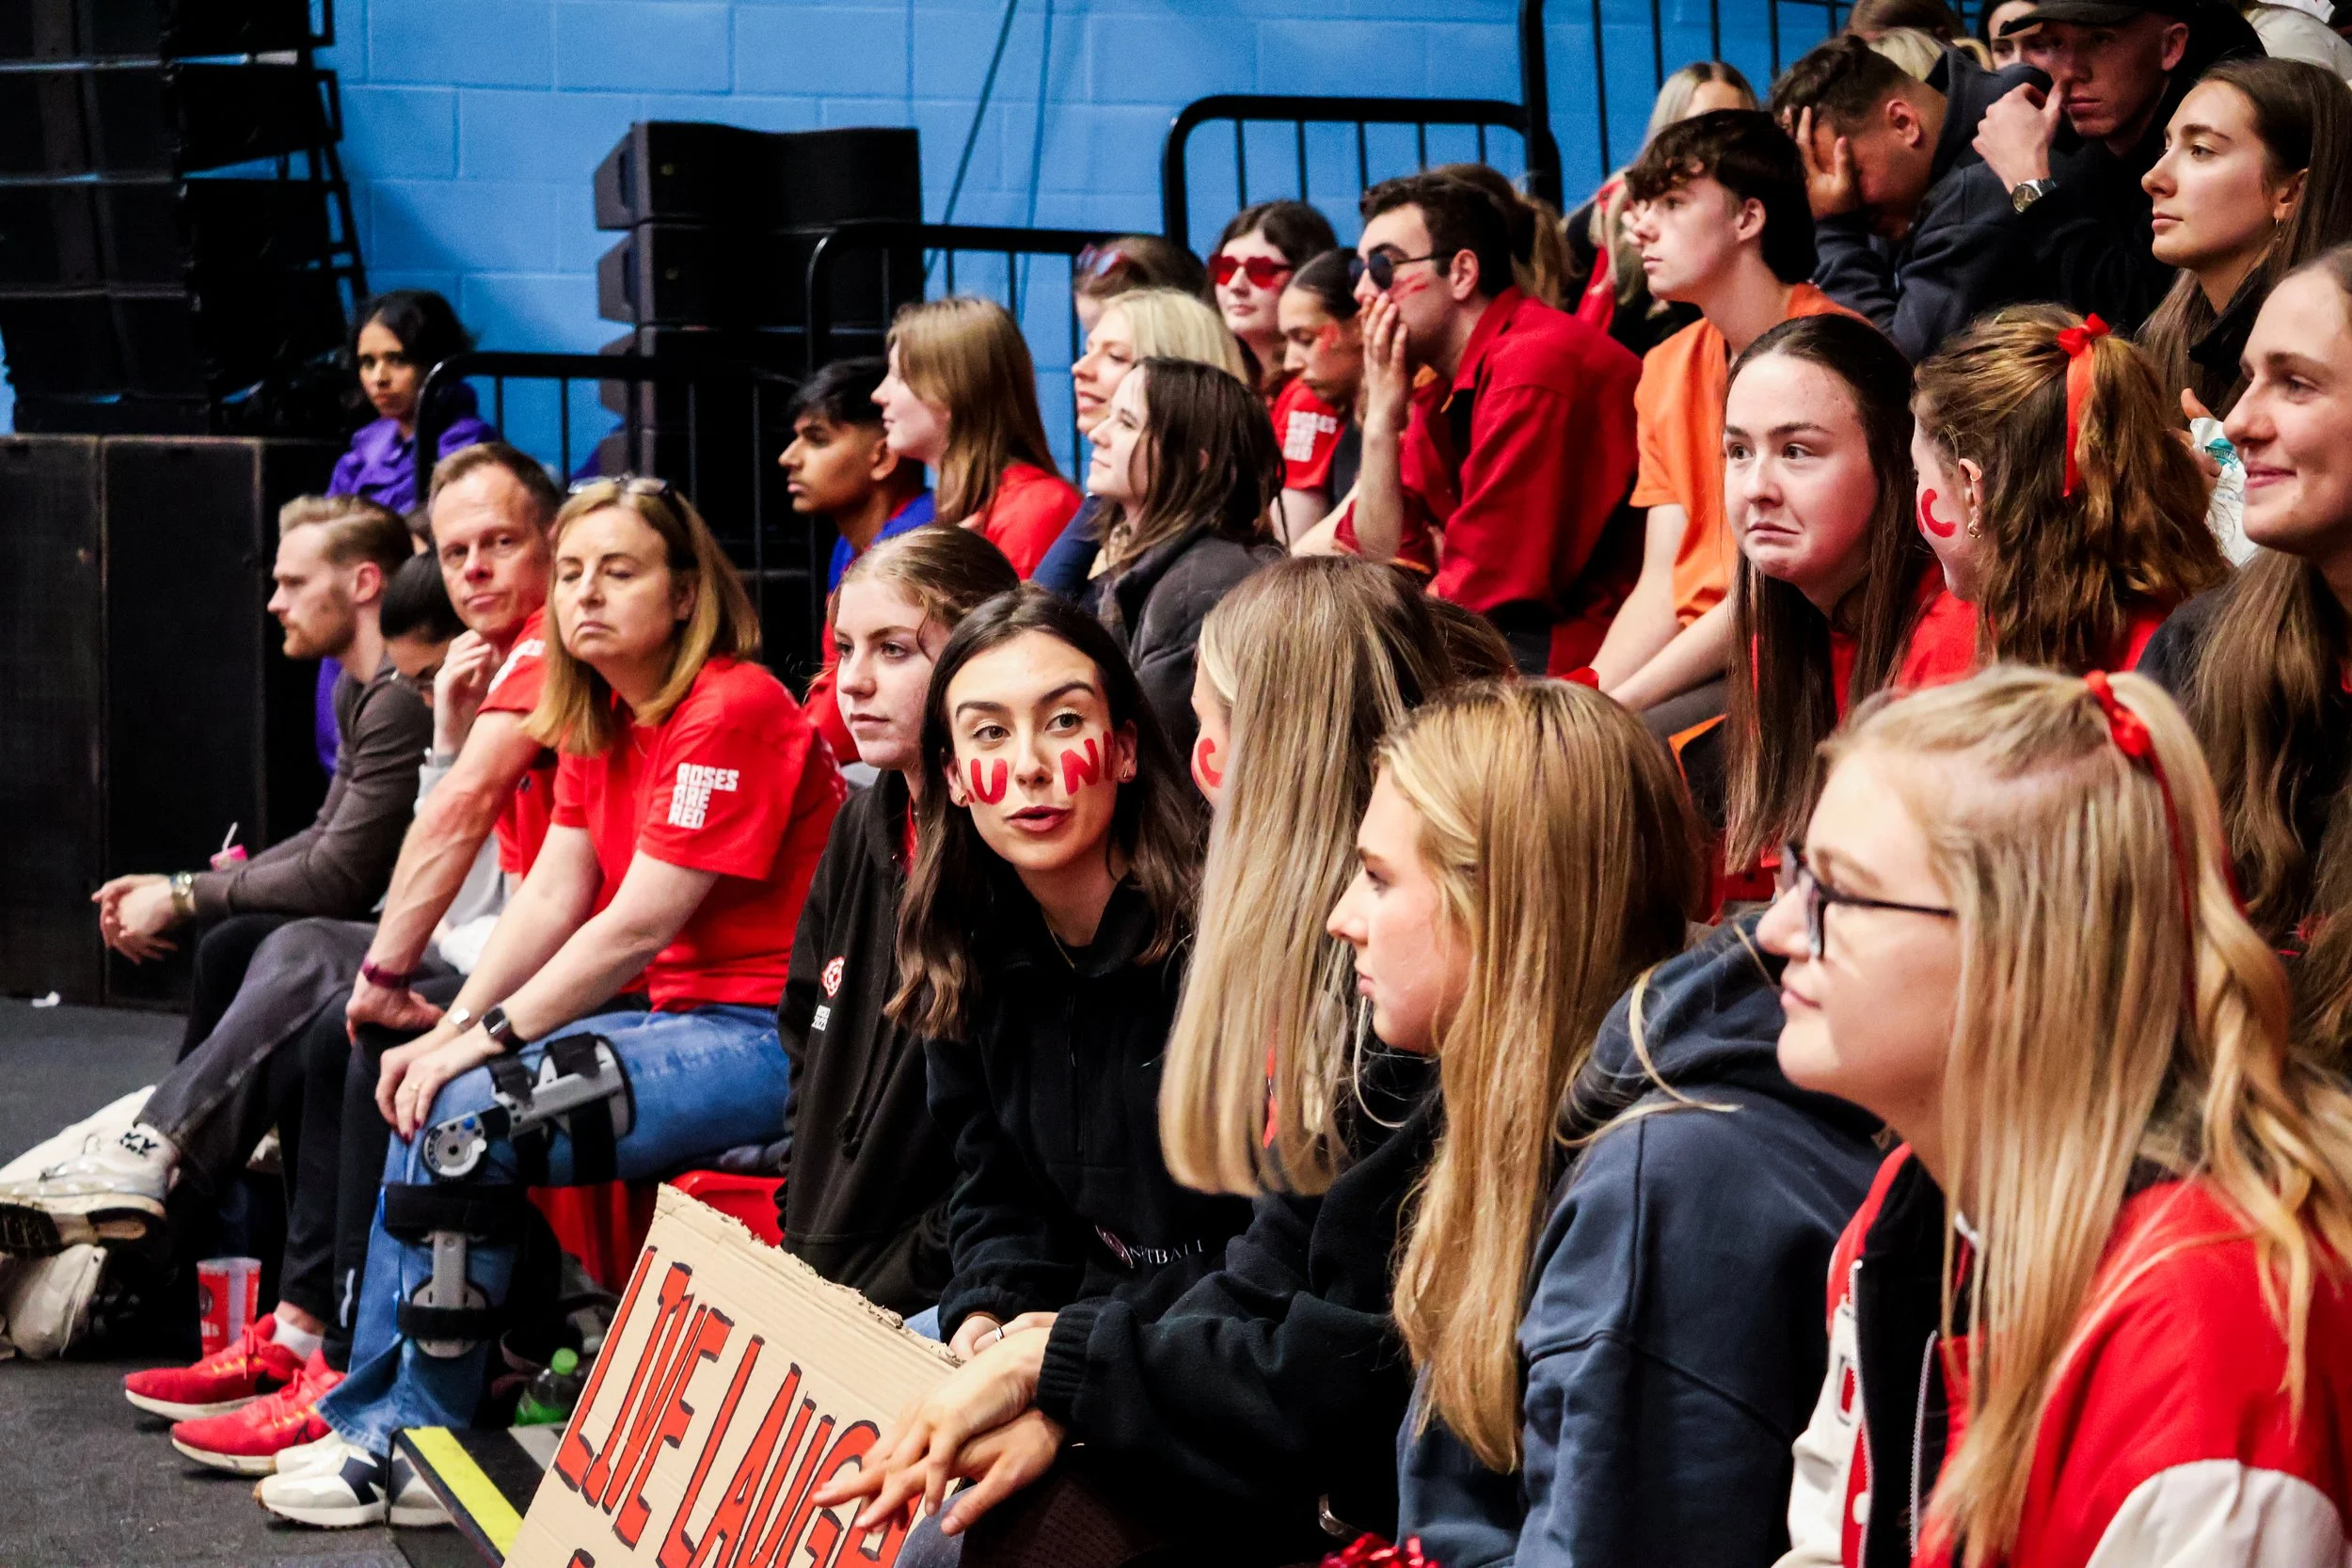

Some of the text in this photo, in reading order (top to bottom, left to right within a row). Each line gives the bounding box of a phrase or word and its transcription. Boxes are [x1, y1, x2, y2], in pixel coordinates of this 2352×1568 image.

[1916, 488, 1956, 538] C
[676, 762, 739, 792] ROSES
[967, 758, 1008, 806] U
[1192, 737, 1223, 788] C
[667, 804, 706, 830] RED
[672, 784, 712, 810] ARE
[552, 1245, 734, 1551] LIVE
